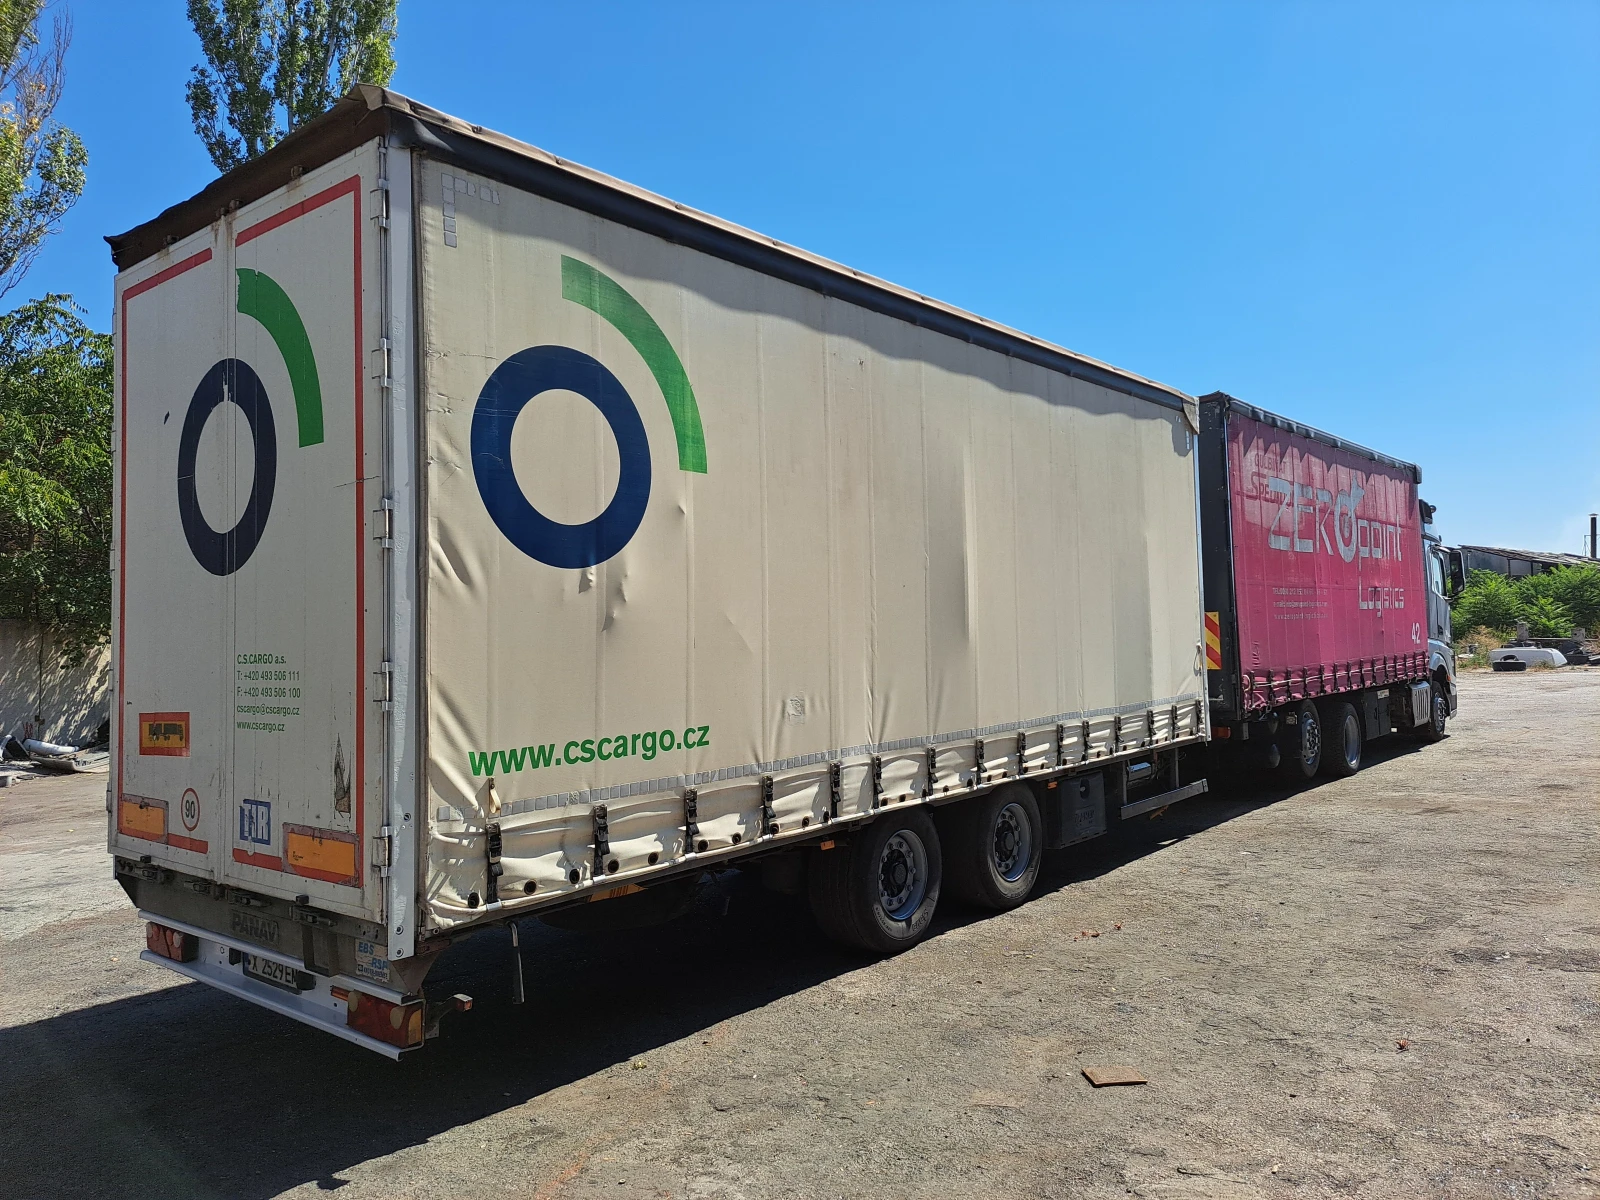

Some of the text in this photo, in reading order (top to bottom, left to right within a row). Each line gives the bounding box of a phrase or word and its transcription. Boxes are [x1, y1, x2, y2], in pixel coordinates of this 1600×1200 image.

[1359, 576, 1405, 617] Logistics
[1412, 622, 1421, 644] 42
[237, 653, 287, 664] C.S.CARGO a.s.
[236, 670, 300, 681] T: +420 493 506 111
[236, 686, 301, 698] F: +420 493 506 100
[236, 703, 300, 717] cscargo@cscargo.cz
[236, 721, 285, 733] www.cscargo.cz
[468, 724, 711, 777] www.cscargo.cz
[185, 799, 196, 819] 90
[243, 803, 269, 840] TIR
[358, 941, 375, 955] EBS
